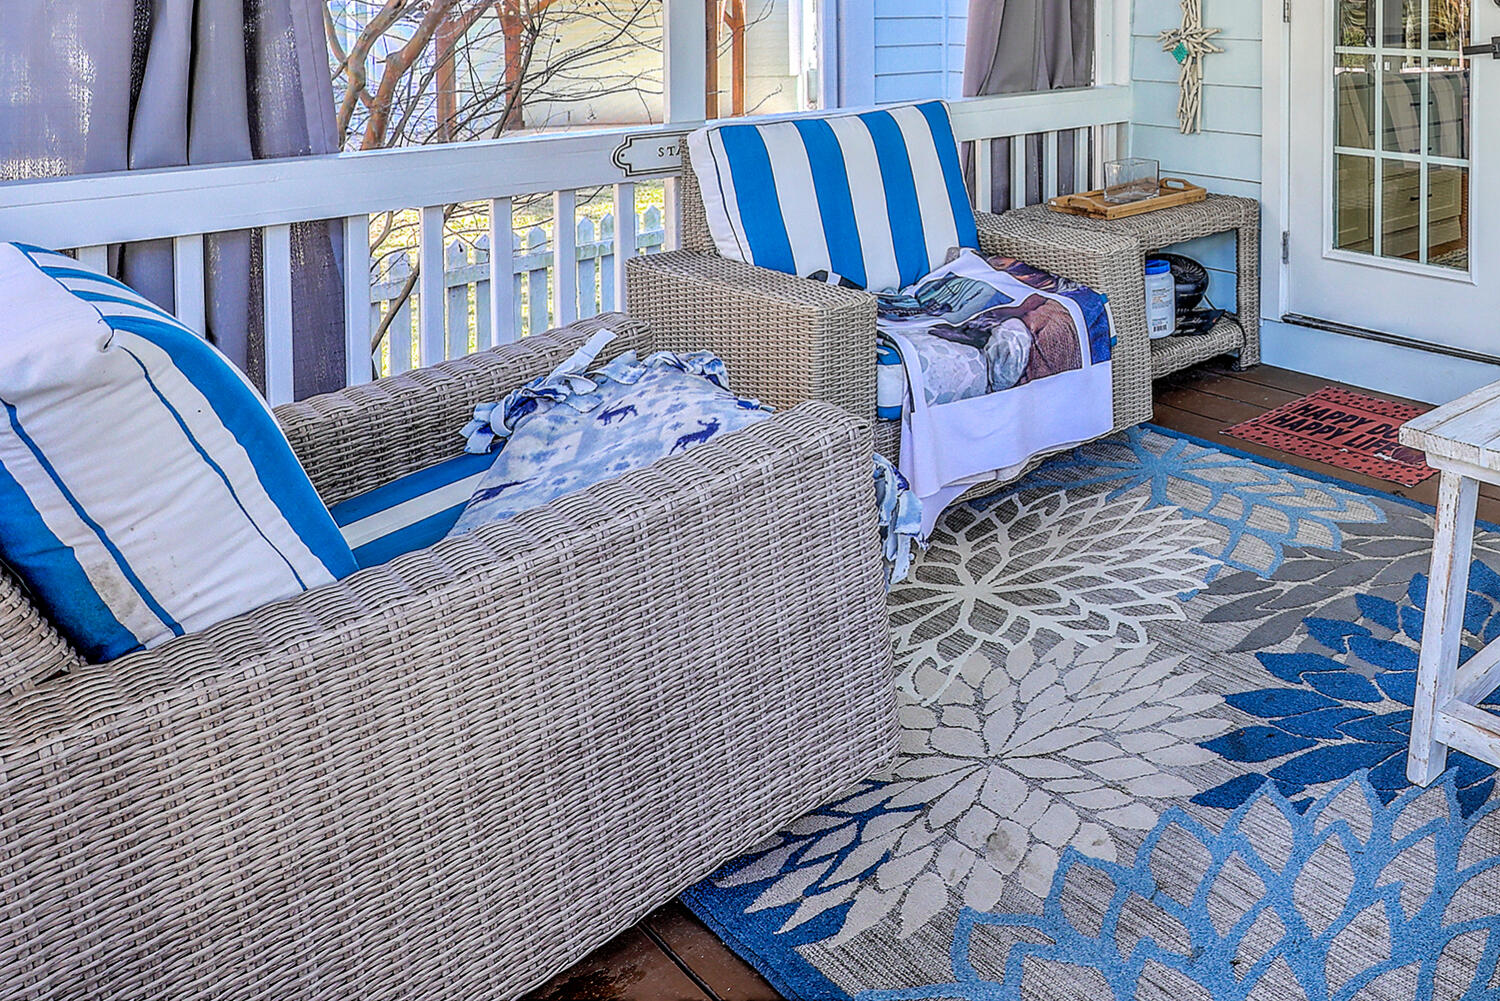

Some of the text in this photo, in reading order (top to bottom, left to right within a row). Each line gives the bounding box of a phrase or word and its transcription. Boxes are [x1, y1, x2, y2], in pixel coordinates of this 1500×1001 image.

[1266, 413, 1401, 454] HAPPY LIFE
[1290, 403, 1400, 439] HAPPY DO
